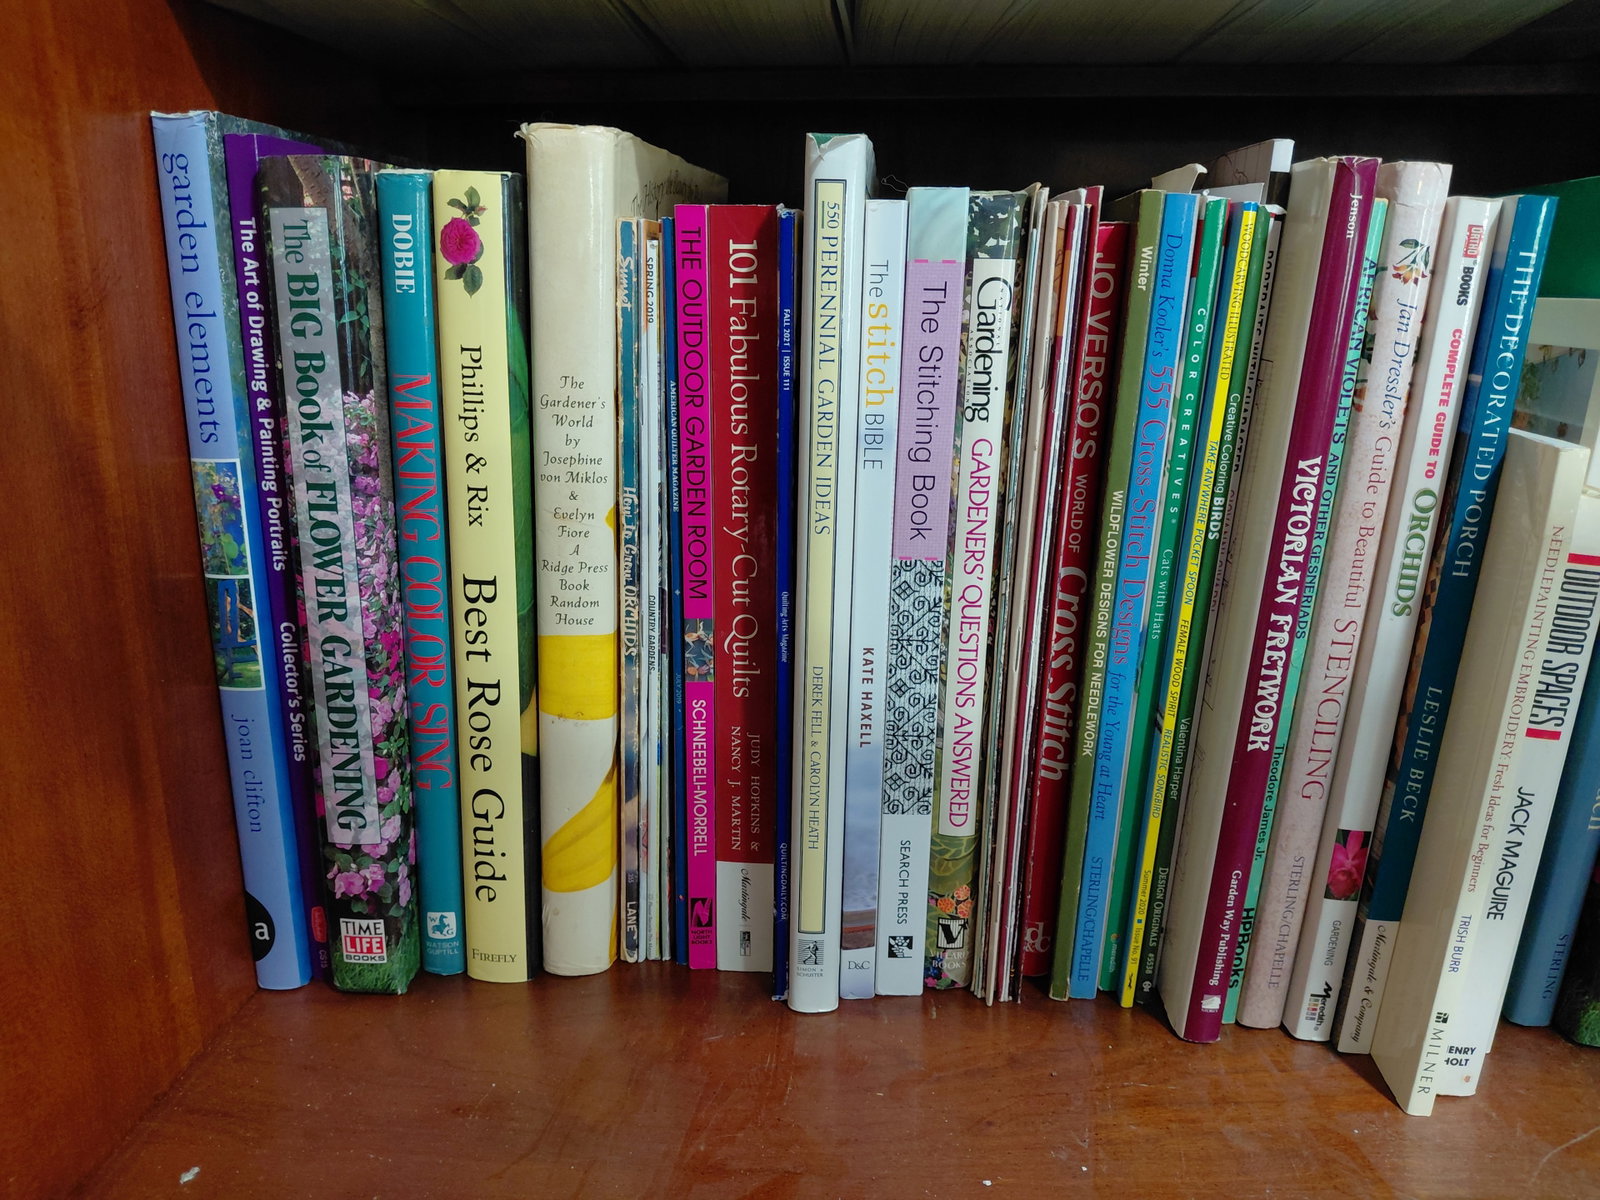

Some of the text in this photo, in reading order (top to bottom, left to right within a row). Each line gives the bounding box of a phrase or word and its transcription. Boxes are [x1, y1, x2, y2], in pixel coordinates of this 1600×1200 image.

[392, 213, 416, 294] DOBIE
[1346, 193, 1362, 239] Jenson
[163, 153, 220, 444] garden elements
[1137, 246, 1153, 291] Winter
[1456, 266, 1474, 306] BOOKS
[814, 202, 840, 535] 550 PERENNIAL GARDEN IDEAS
[863, 260, 895, 470] The stitch BIBLE
[964, 277, 1012, 423] Gardening
[1189, 308, 1207, 379] COLOR
[240, 217, 285, 571] The Art of Drawing & Painting Portraits
[458, 344, 489, 527] Phillips & Rix
[540, 376, 606, 409] The Gardener's
[552, 414, 594, 428] World
[681, 227, 708, 599] THE OUTDOOR GARDEN ROOM
[908, 281, 947, 540] The Stitching Book
[1223, 394, 1240, 442] Creative
[1425, 329, 1462, 479] COMPLETE GUIDE TO
[540, 471, 608, 484] von Miklos
[543, 451, 602, 467] Josephine
[565, 434, 581, 448] by
[670, 380, 680, 512] AMERICAN QUILTER MAGAZINE
[723, 239, 760, 698] 101 Fabulous Quilts
[1214, 443, 1232, 493] Coloring
[283, 219, 367, 831] The BIG Book of FLOWER GARDENING
[553, 507, 595, 521] Evelyn
[558, 525, 590, 538] Fiore
[569, 491, 579, 501] &
[1069, 474, 1088, 532] WORLD
[1094, 234, 1183, 820] Donna Kooler's 555 Designs the Young Heart
[1208, 497, 1225, 540] BIRDS
[1314, 453, 1338, 539] AND OTHER
[1452, 489, 1486, 577] PORCH
[391, 373, 453, 790] MAKING COLOR SING
[541, 560, 608, 574] Ridge Press
[559, 580, 590, 591] Book
[569, 544, 580, 556] A
[1184, 529, 1204, 605] POCKET SPOON
[1301, 298, 1417, 800] Jan Dressler's Guide Beautiful STENCILING
[1390, 487, 1438, 617] ORCHIDS
[550, 595, 600, 608] Random
[555, 613, 594, 625] House
[624, 585, 638, 656] ORCHIDS
[1082, 491, 1124, 757] WILDFLOWER DESIGNS FOR NEEDLEWORK
[1151, 549, 1174, 640] Cats with Hats
[1247, 456, 1322, 753] VICTORIAN FRETWORK
[280, 623, 306, 762] Collector's Series
[860, 647, 874, 748] KATE HAXELL
[949, 584, 983, 827] QUESTIONS ANSWERED
[1166, 619, 1190, 718] FEMALE WOOD SPIRIT
[1528, 660, 1579, 728] SPACES
[231, 714, 265, 833] joan clifton
[462, 574, 508, 902] Best Rose Guide
[692, 699, 708, 856] SCHNEEBELI-MORRELL
[808, 666, 823, 850] DEREK FELL CAROLYN HEATH
[1152, 728, 1173, 819] REALISTIC SONGBIRD
[1169, 718, 1191, 801] Valentina Harper
[1400, 686, 1442, 823] LESLIE BECK
[731, 726, 741, 851] NANCY MARTIN
[747, 733, 760, 834] JUDY HOPKINS
[1257, 743, 1284, 843] Theodore James
[1468, 763, 1509, 893] Fresh Ideas Beginners
[1487, 786, 1535, 921] JACK MAGUIRE
[741, 868, 752, 923] Martingale
[780, 843, 788, 921] QUILTINGDAILY.COM
[897, 840, 911, 925] SEARCH PRESS
[1149, 867, 1168, 947] DESIGN ORIGINALS
[342, 920, 383, 953] TIME LIFE
[1209, 870, 1242, 987] Garden Way Publishing
[1324, 920, 1341, 966] GARDENING
[1448, 914, 1471, 973] TRISH BURR
[1417, 1028, 1444, 1094] MILNER
